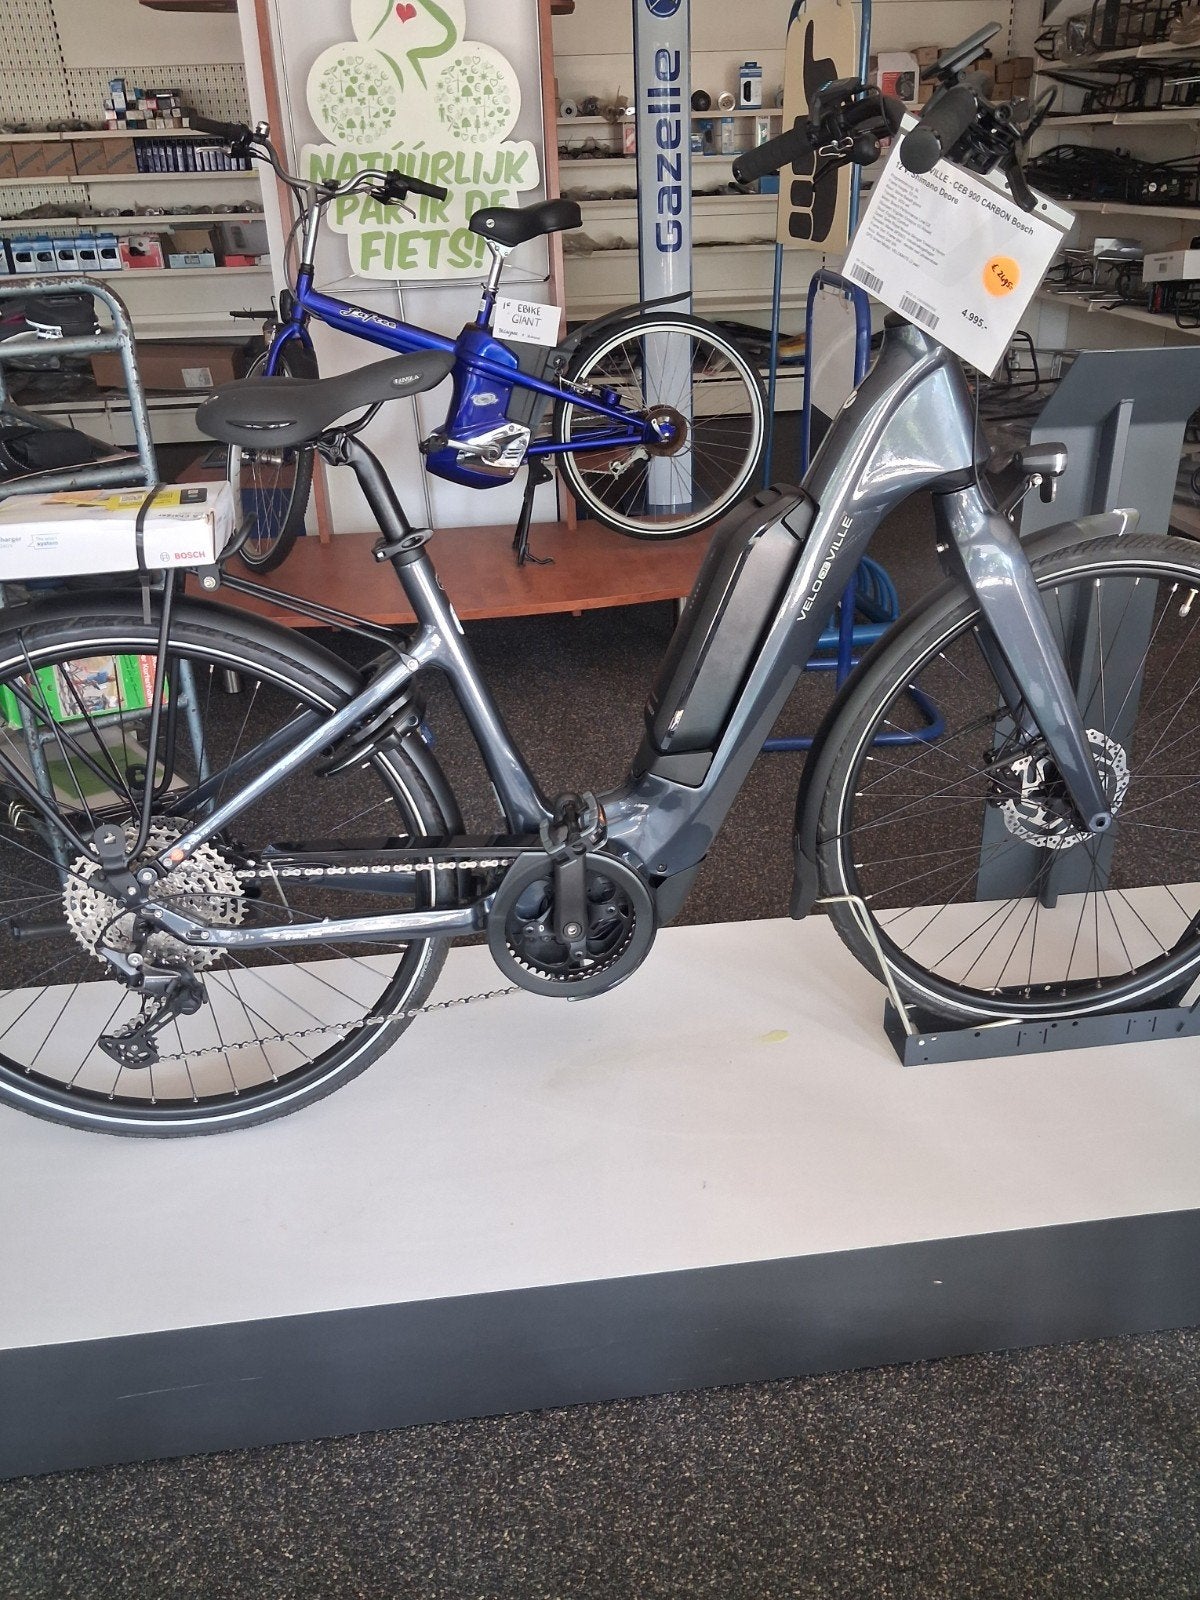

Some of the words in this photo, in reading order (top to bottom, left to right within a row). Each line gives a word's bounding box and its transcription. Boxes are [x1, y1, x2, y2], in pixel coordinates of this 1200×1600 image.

[647, 48, 683, 253] Gazelle
[911, 173, 938, 192] Shimano
[939, 188, 959, 204] Deore
[420, 190, 454, 224] IK
[953, 181, 968, 195] CEB
[968, 191, 980, 203] 900
[981, 198, 1011, 221] CARBON
[1011, 217, 1034, 235] Bosch
[361, 227, 485, 271] FIETS!
[511, 313, 542, 327] GIANT
[517, 304, 541, 316] EBIKE
[174, 550, 206, 560] BOSCH
